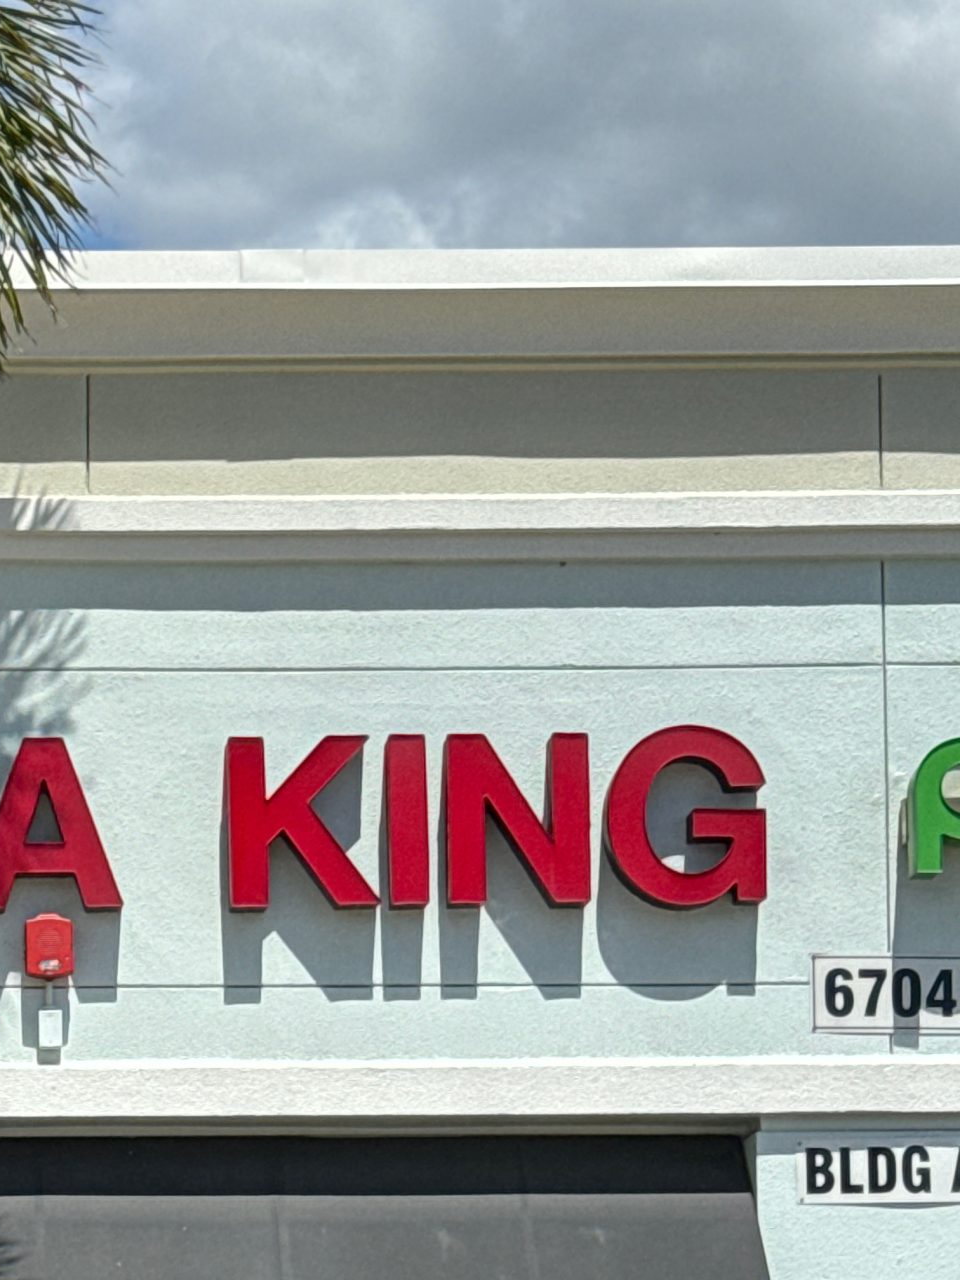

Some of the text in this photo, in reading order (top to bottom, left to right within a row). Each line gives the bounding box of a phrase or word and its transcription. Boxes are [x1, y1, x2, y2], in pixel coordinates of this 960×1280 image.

[226, 725, 767, 911] KING
[824, 967, 957, 1018] 6704
[804, 1145, 931, 1194] BLDG
